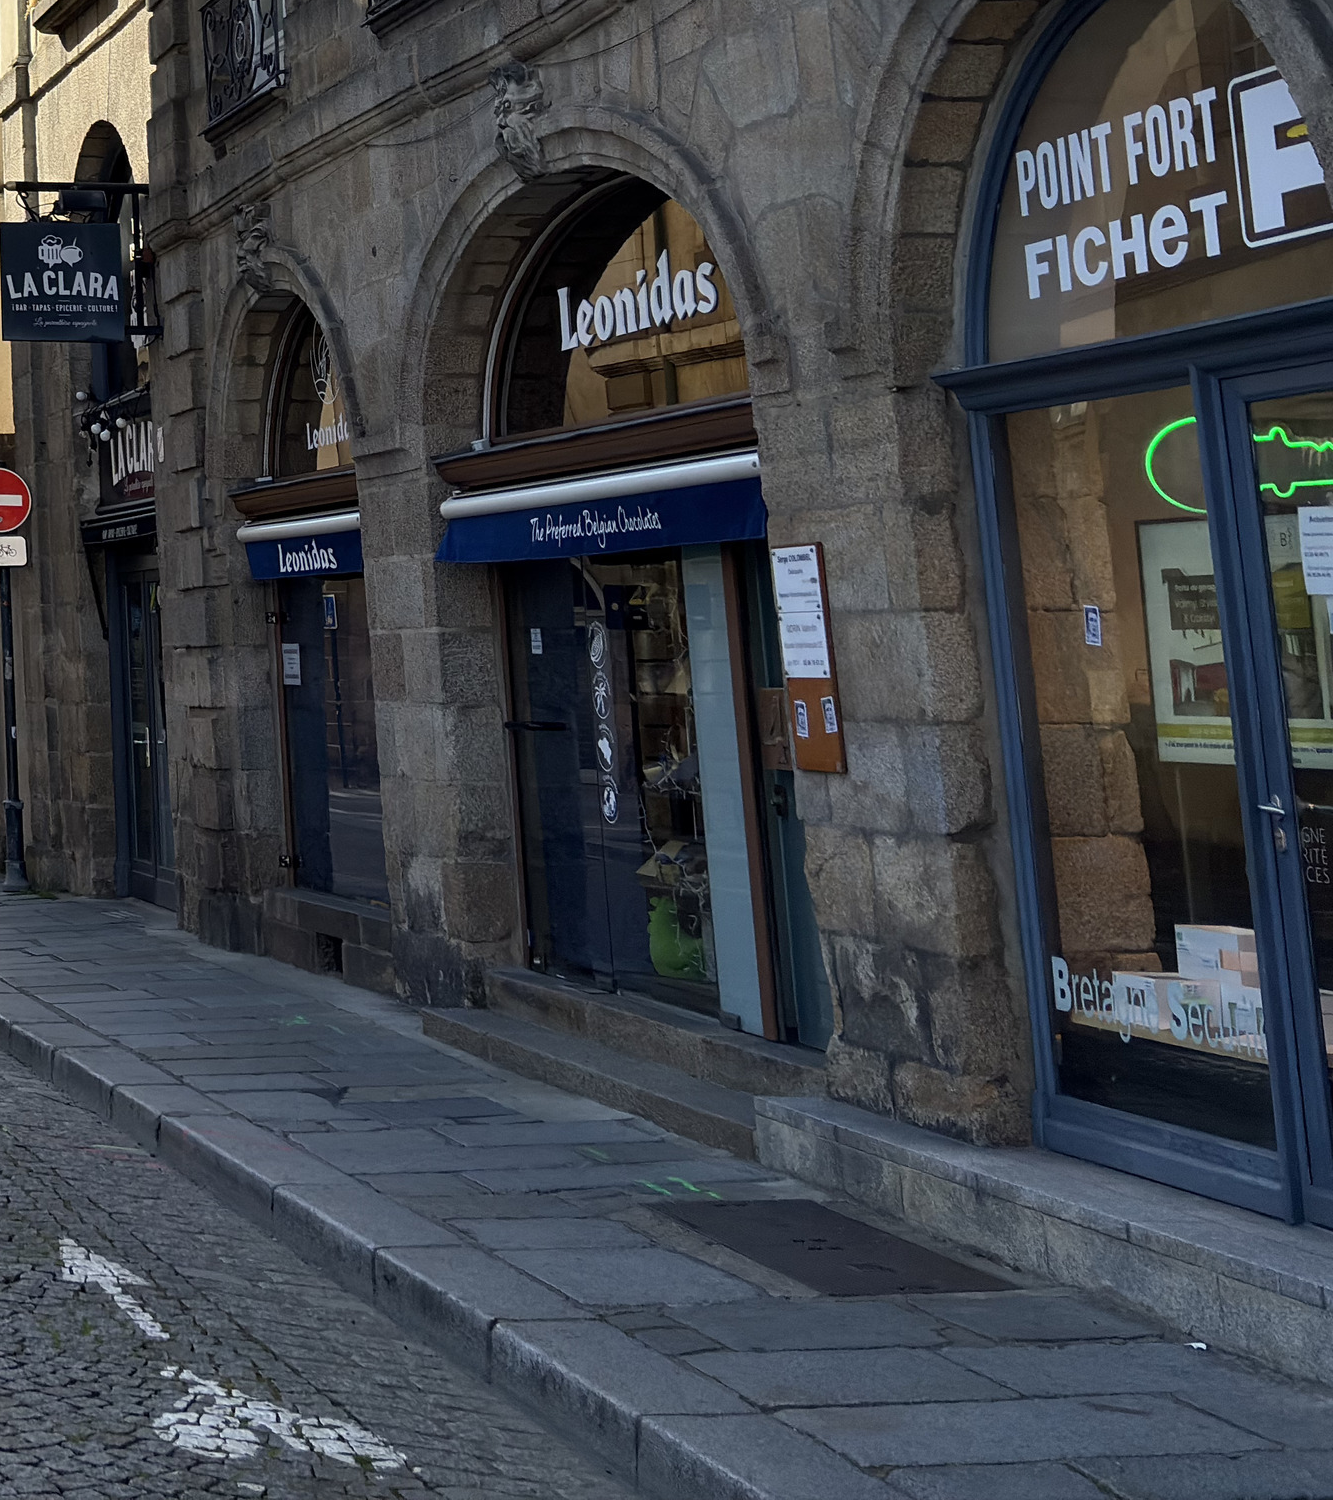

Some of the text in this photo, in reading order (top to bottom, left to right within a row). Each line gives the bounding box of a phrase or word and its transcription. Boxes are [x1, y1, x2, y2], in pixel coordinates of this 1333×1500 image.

[1015, 86, 1218, 217] POINT FORT
[5, 270, 119, 301] LA CLARA
[557, 248, 718, 351] Leonidas
[31, 303, 51, 312] TAPAS
[305, 412, 350, 451] Leonid
[109, 420, 154, 487] LA CLAR
[530, 505, 662, 549] The Preferred Belgian Chocolates
[277, 538, 338, 573] Leonidas
